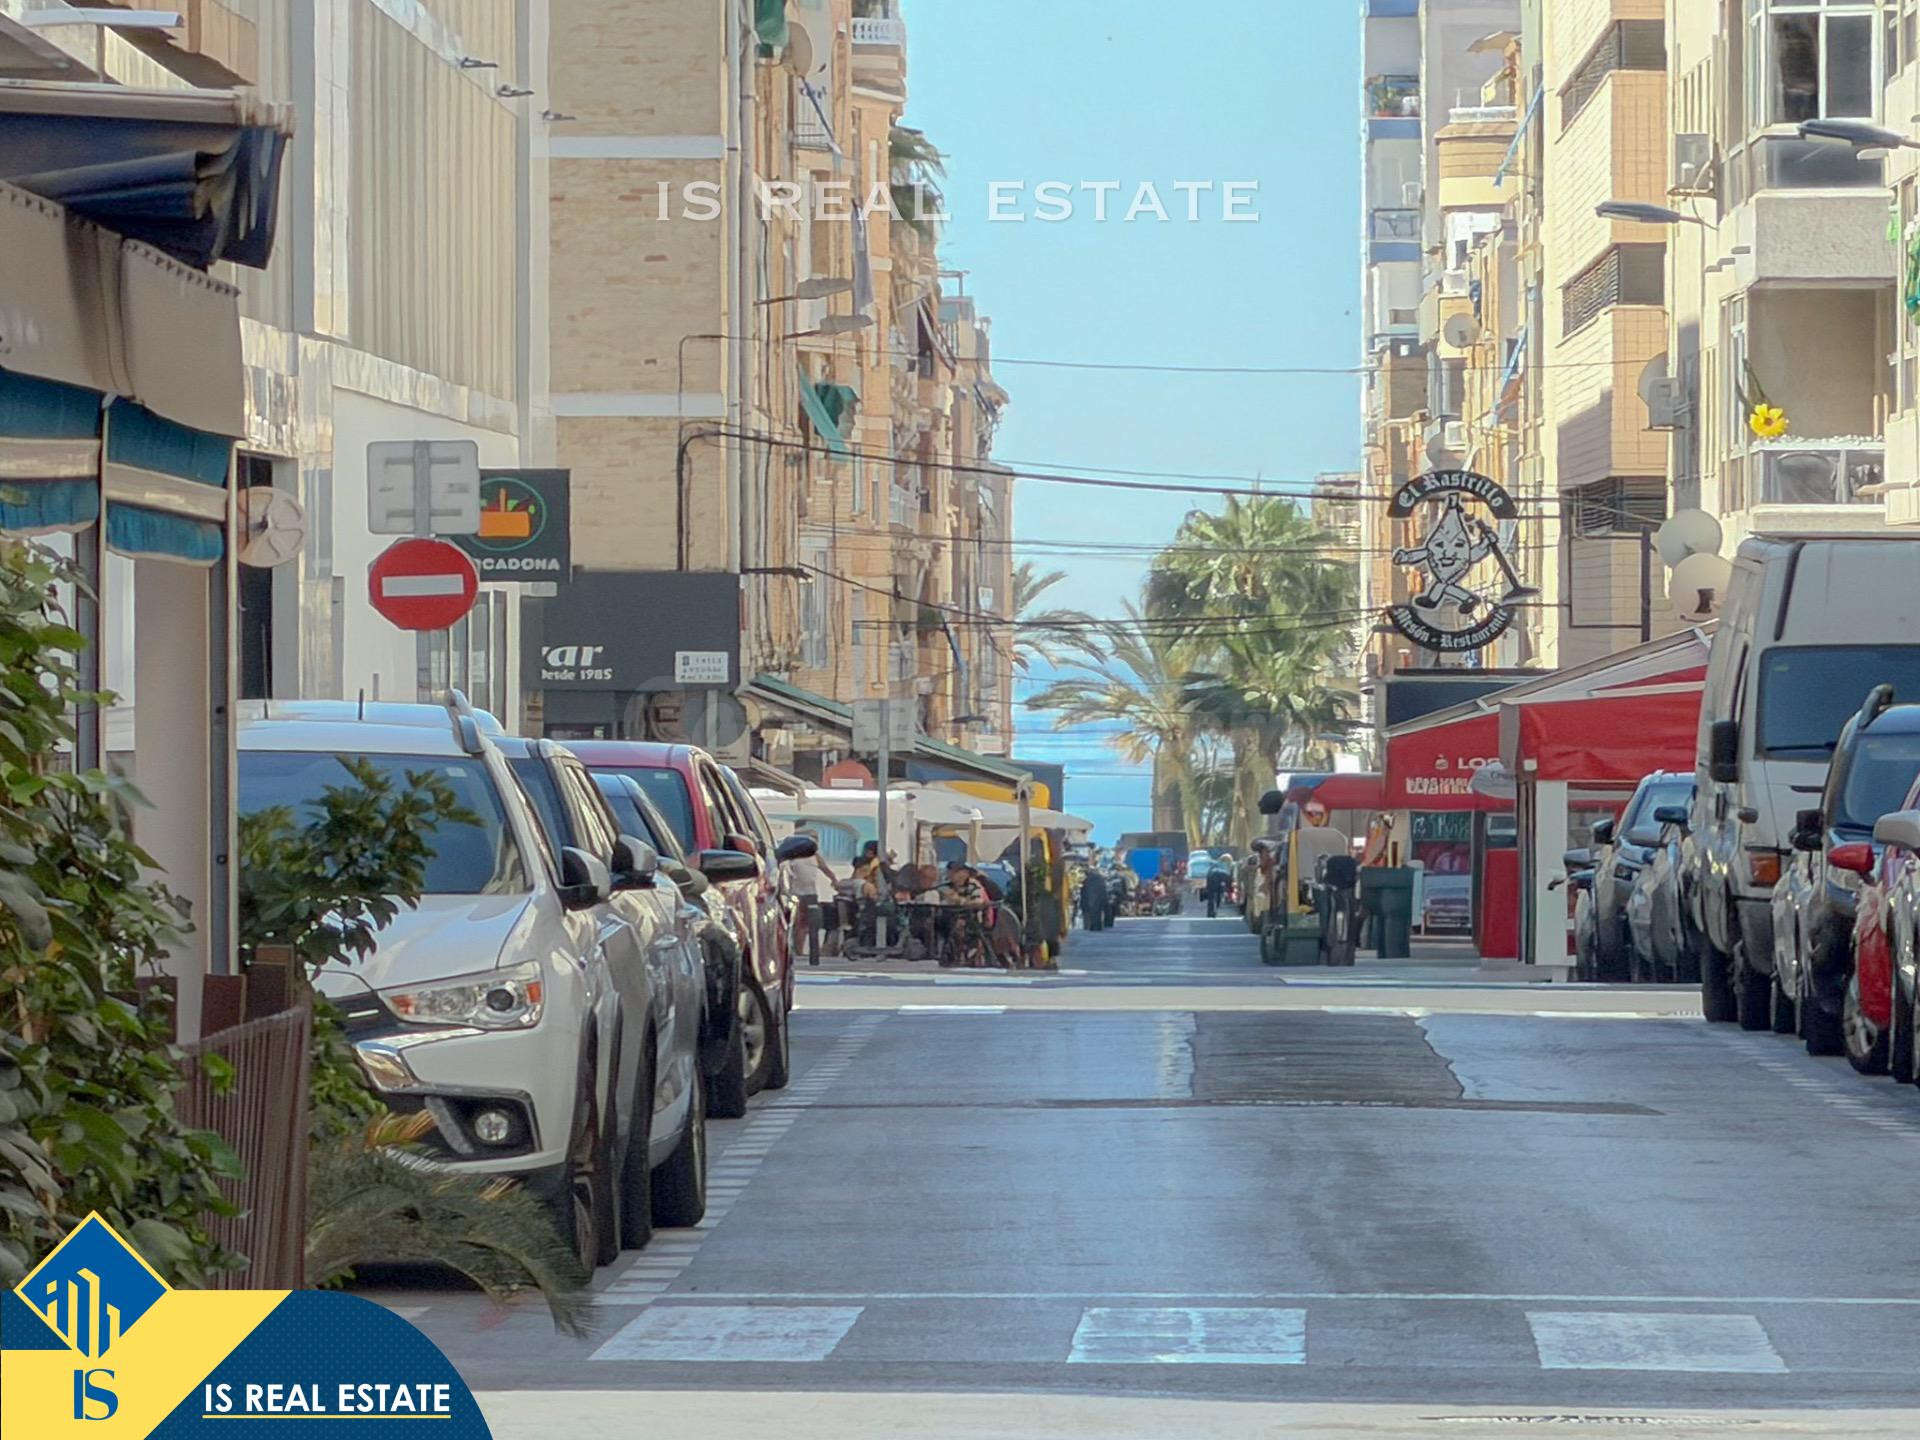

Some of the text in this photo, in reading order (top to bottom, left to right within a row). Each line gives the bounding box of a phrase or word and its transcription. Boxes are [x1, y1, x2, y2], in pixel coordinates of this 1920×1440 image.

[1398, 473, 1504, 508] El Rastrillo
[579, 667, 614, 681] 1985
